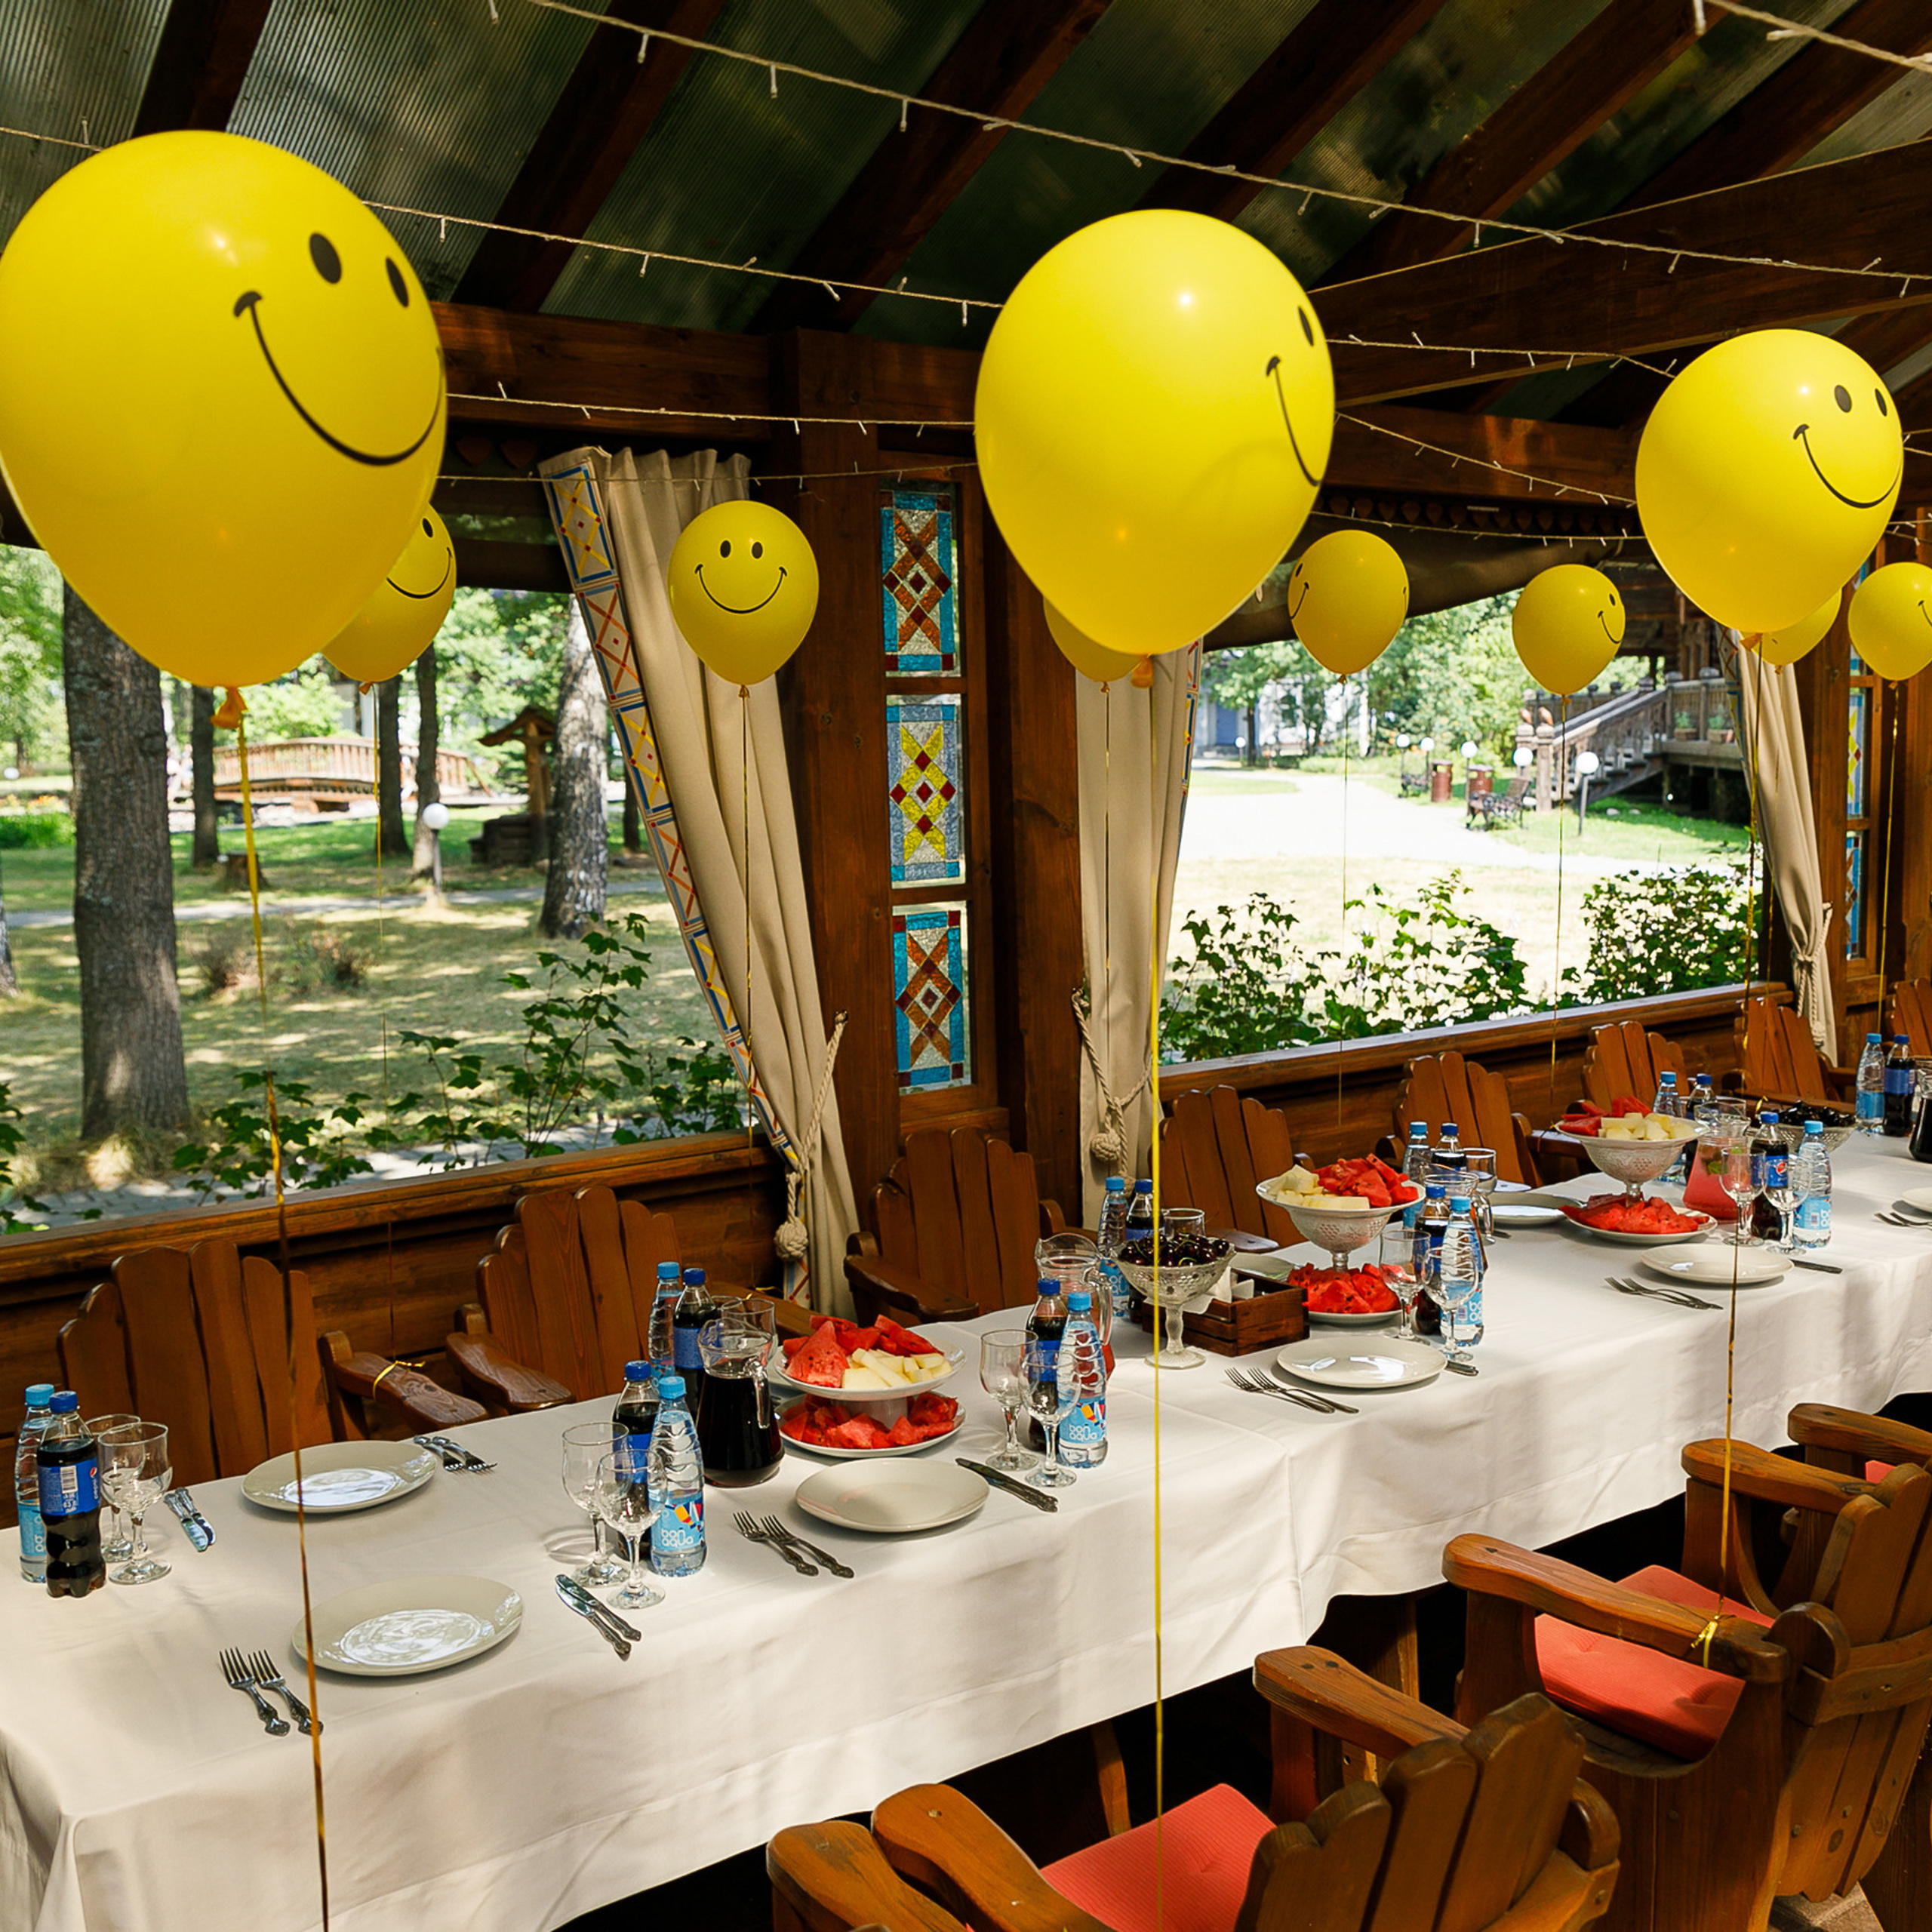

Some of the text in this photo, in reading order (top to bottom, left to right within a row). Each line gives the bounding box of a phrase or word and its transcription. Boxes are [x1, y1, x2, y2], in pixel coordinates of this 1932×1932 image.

[1069, 1423, 1091, 1433] bon
[1069, 1432, 1097, 1441] aqua
[661, 1528, 686, 1538] bon
[662, 1537, 694, 1548] aqua
